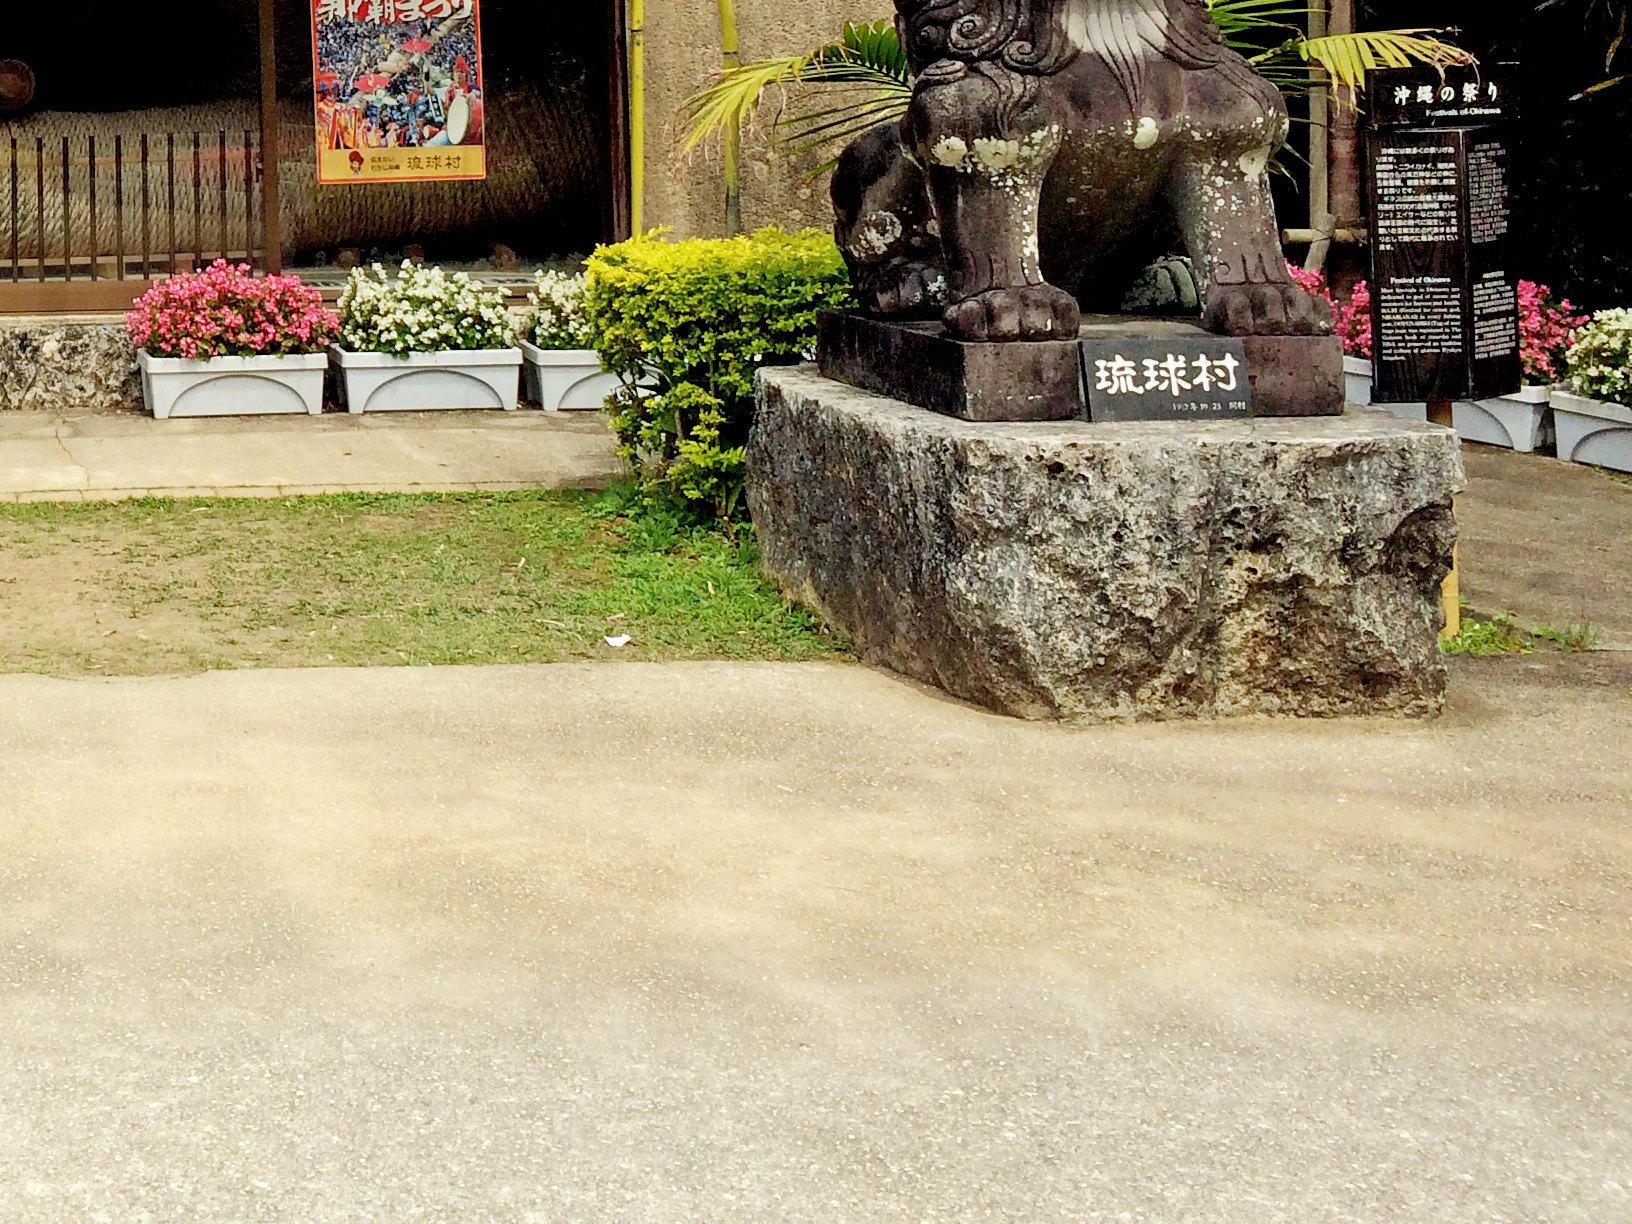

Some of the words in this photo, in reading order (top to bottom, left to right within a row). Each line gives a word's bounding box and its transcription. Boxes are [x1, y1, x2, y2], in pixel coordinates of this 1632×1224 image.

[1394, 82, 1497, 105] 沖縄の祭り
[406, 156, 461, 170] 琉球村
[1095, 353, 1239, 396] 琉球村
